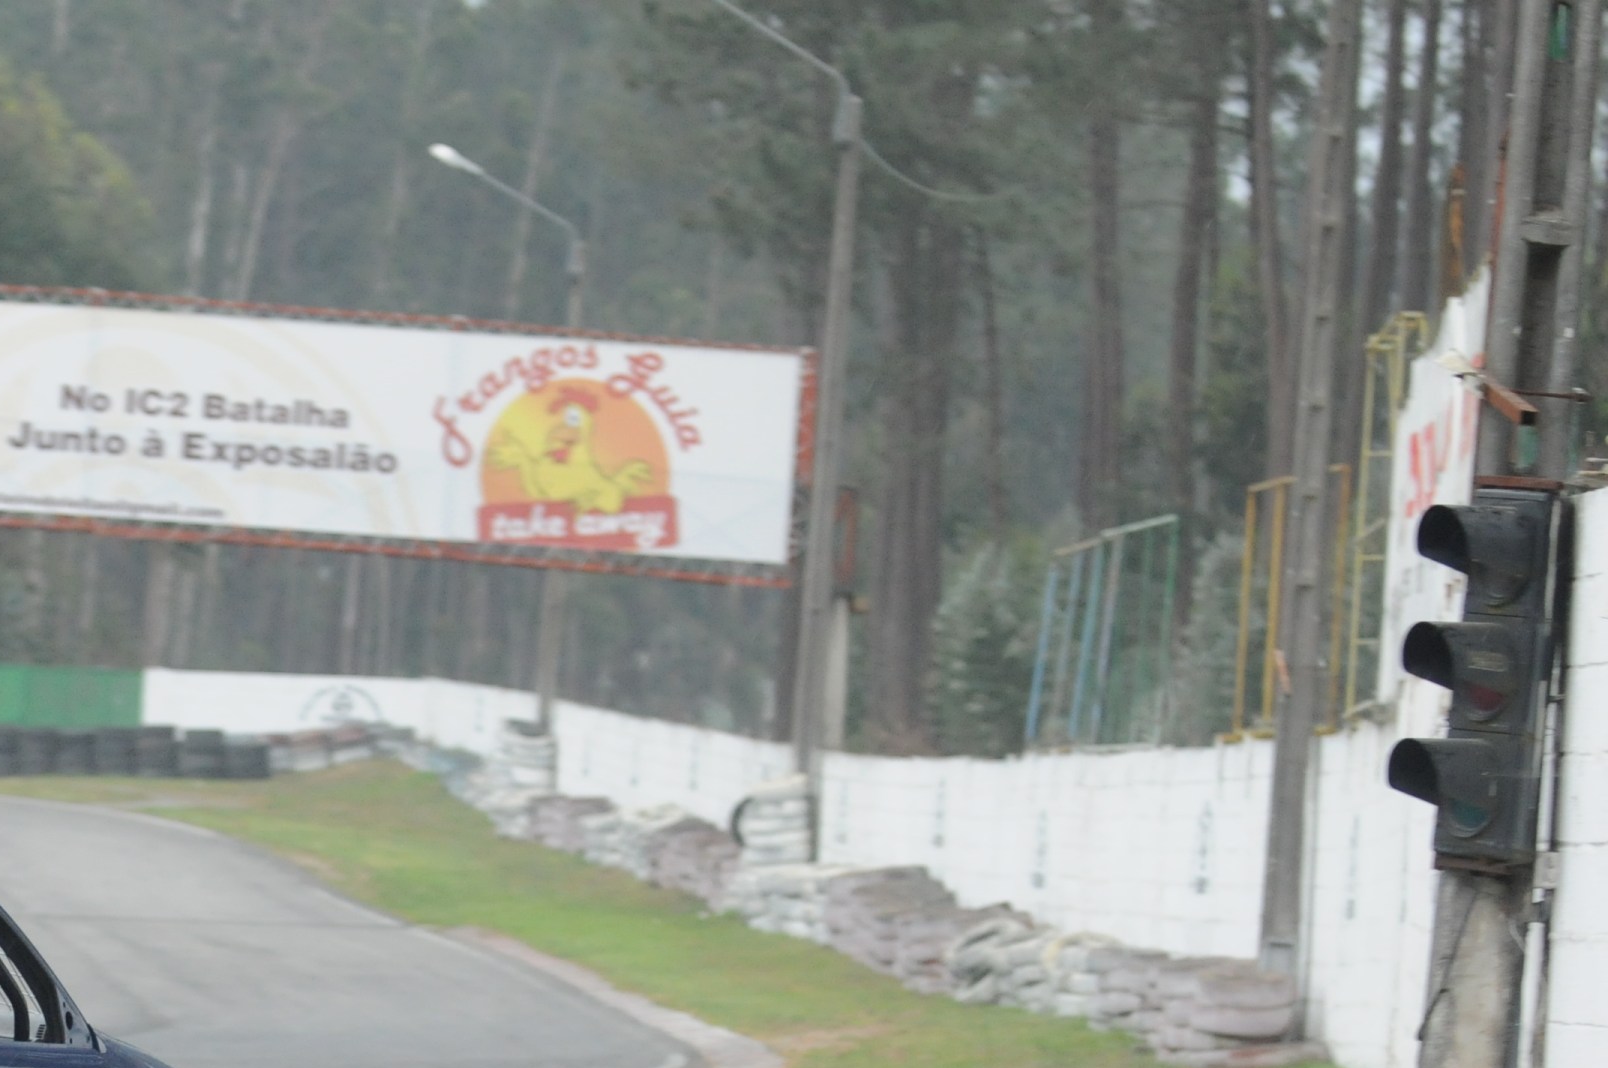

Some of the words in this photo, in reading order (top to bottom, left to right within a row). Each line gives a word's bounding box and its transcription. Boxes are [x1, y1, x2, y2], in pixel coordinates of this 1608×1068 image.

[58, 385, 111, 413] No
[124, 390, 190, 418] IC2
[202, 394, 351, 429] Batalha
[7, 422, 127, 456] Junto
[139, 428, 166, 459] à
[180, 433, 399, 476] Exposalão
